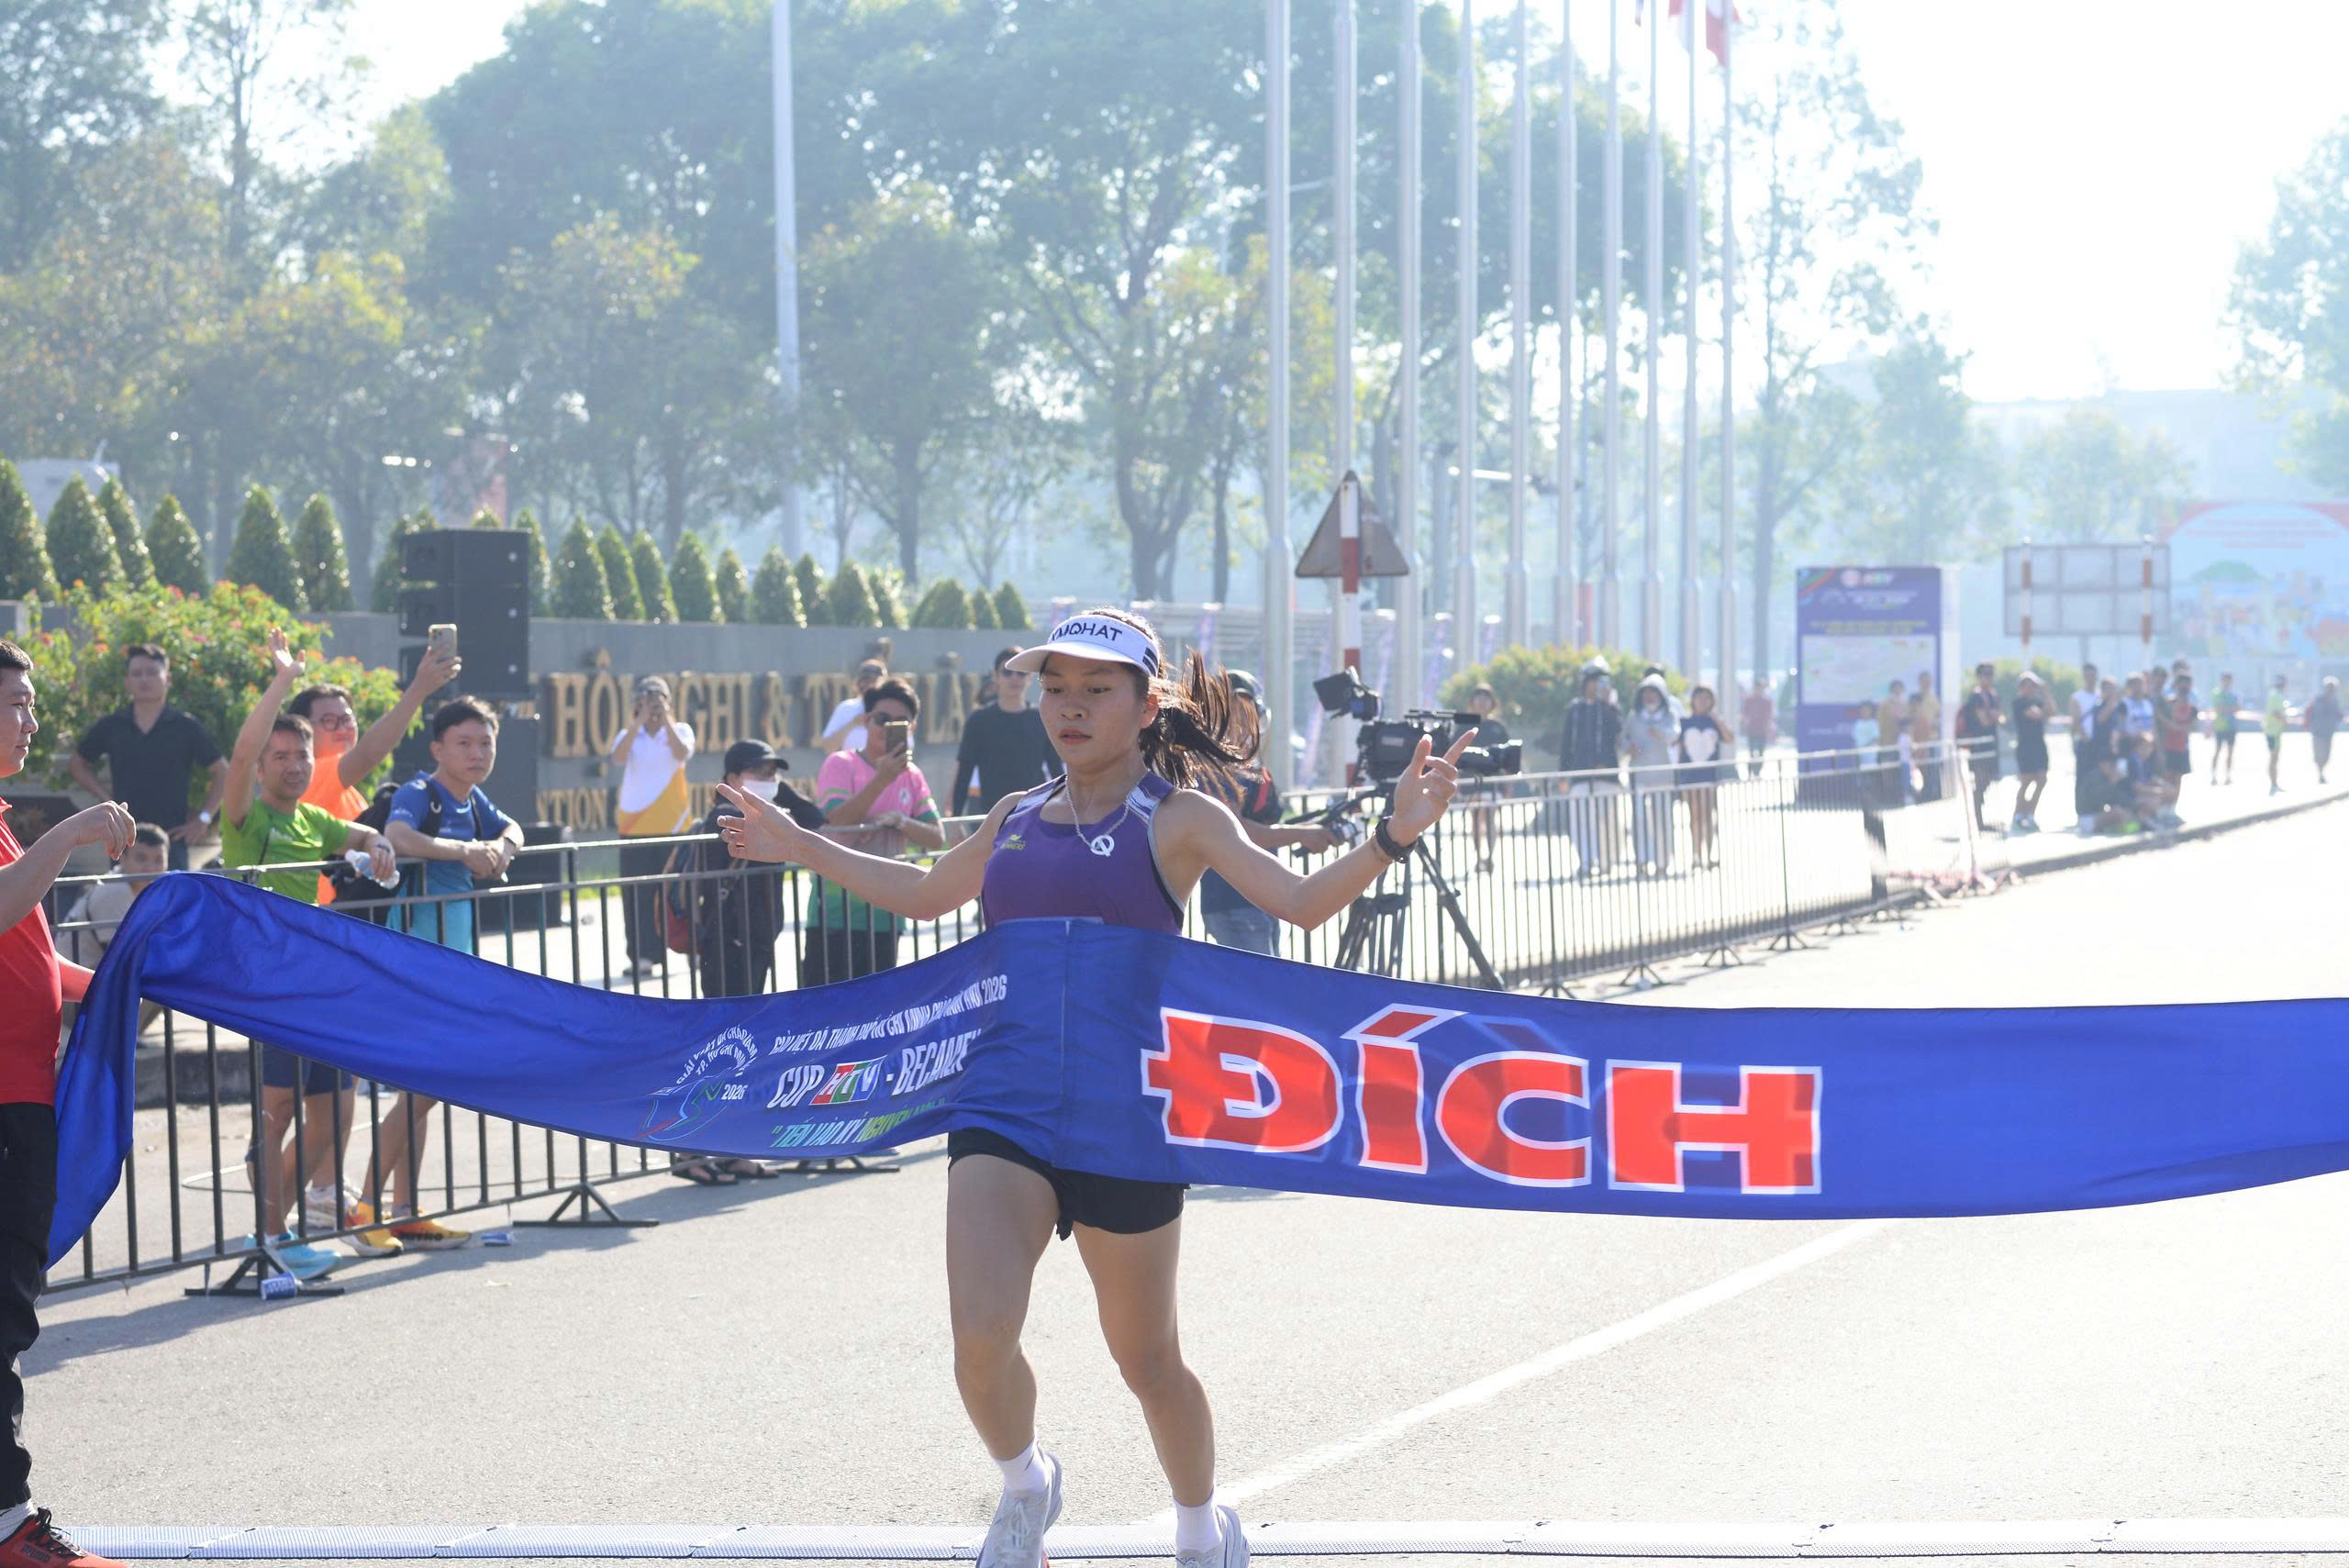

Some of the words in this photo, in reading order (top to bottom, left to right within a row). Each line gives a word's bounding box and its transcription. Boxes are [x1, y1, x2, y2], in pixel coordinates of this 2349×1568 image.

[765, 671, 794, 751] &
[982, 974, 1008, 1004] 2026
[721, 1084, 748, 1100] 2026
[766, 1064, 825, 1108] CUP
[818, 1062, 881, 1097] HTV
[1141, 1003, 1822, 1195] ĐÍCH
